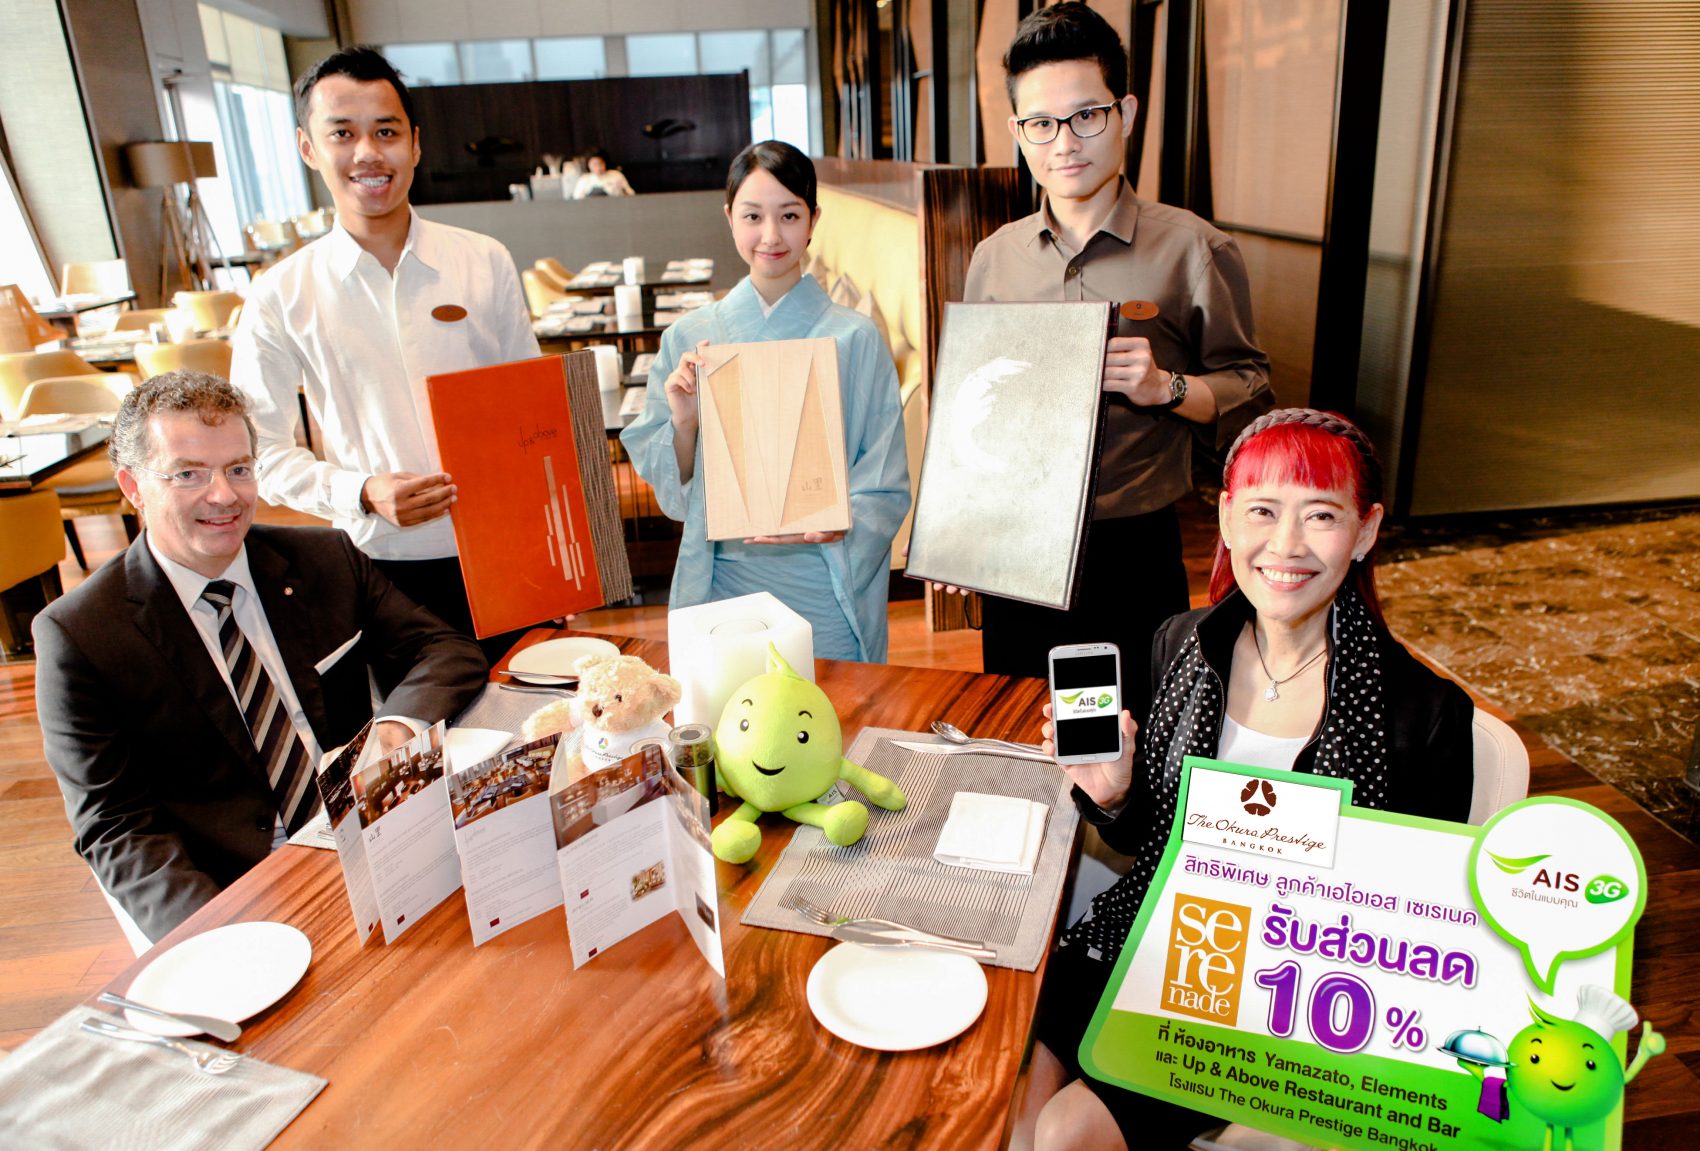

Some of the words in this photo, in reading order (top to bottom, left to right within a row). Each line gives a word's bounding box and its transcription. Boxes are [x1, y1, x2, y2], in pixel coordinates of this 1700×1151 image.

[1078, 696, 1096, 707] AIS
[1187, 813, 1215, 829] The
[1215, 819, 1259, 838] Okura
[1259, 827, 1327, 852] Prestige
[1222, 837, 1283, 855] BANGKOK
[1184, 854, 1269, 886] สิทธิพิเศษ
[1275, 875, 1398, 911] ลูกค้าเอไอเอส
[1406, 900, 1477, 926] เซเรเนด
[1532, 868, 1580, 892] AIS
[1589, 879, 1623, 899] 3G
[1262, 903, 1477, 988] รับส่วนลด
[1256, 961, 1376, 1053] 10
[1385, 1006, 1426, 1049] %
[1155, 1050, 1178, 1065] และ
[1182, 1053, 1206, 1075] Up
[1209, 1061, 1222, 1078] &
[1226, 1065, 1280, 1092] Above
[1284, 1080, 1383, 1119] Restaurant
[1386, 1113, 1423, 1129] and
[1427, 1116, 1462, 1139] Bar
[1157, 1020, 1171, 1042] ที่
[1173, 1028, 1257, 1064] ห้องอาหาร
[1265, 1051, 1355, 1091] Yamazato,
[1361, 1075, 1448, 1111] Elements
[1168, 1071, 1215, 1098] โรงแรม
[1218, 1086, 1246, 1107] The
[1249, 1095, 1295, 1119] Okura
[1298, 1108, 1364, 1138] Prestige
[1367, 1127, 1438, 1151] Bangkok
